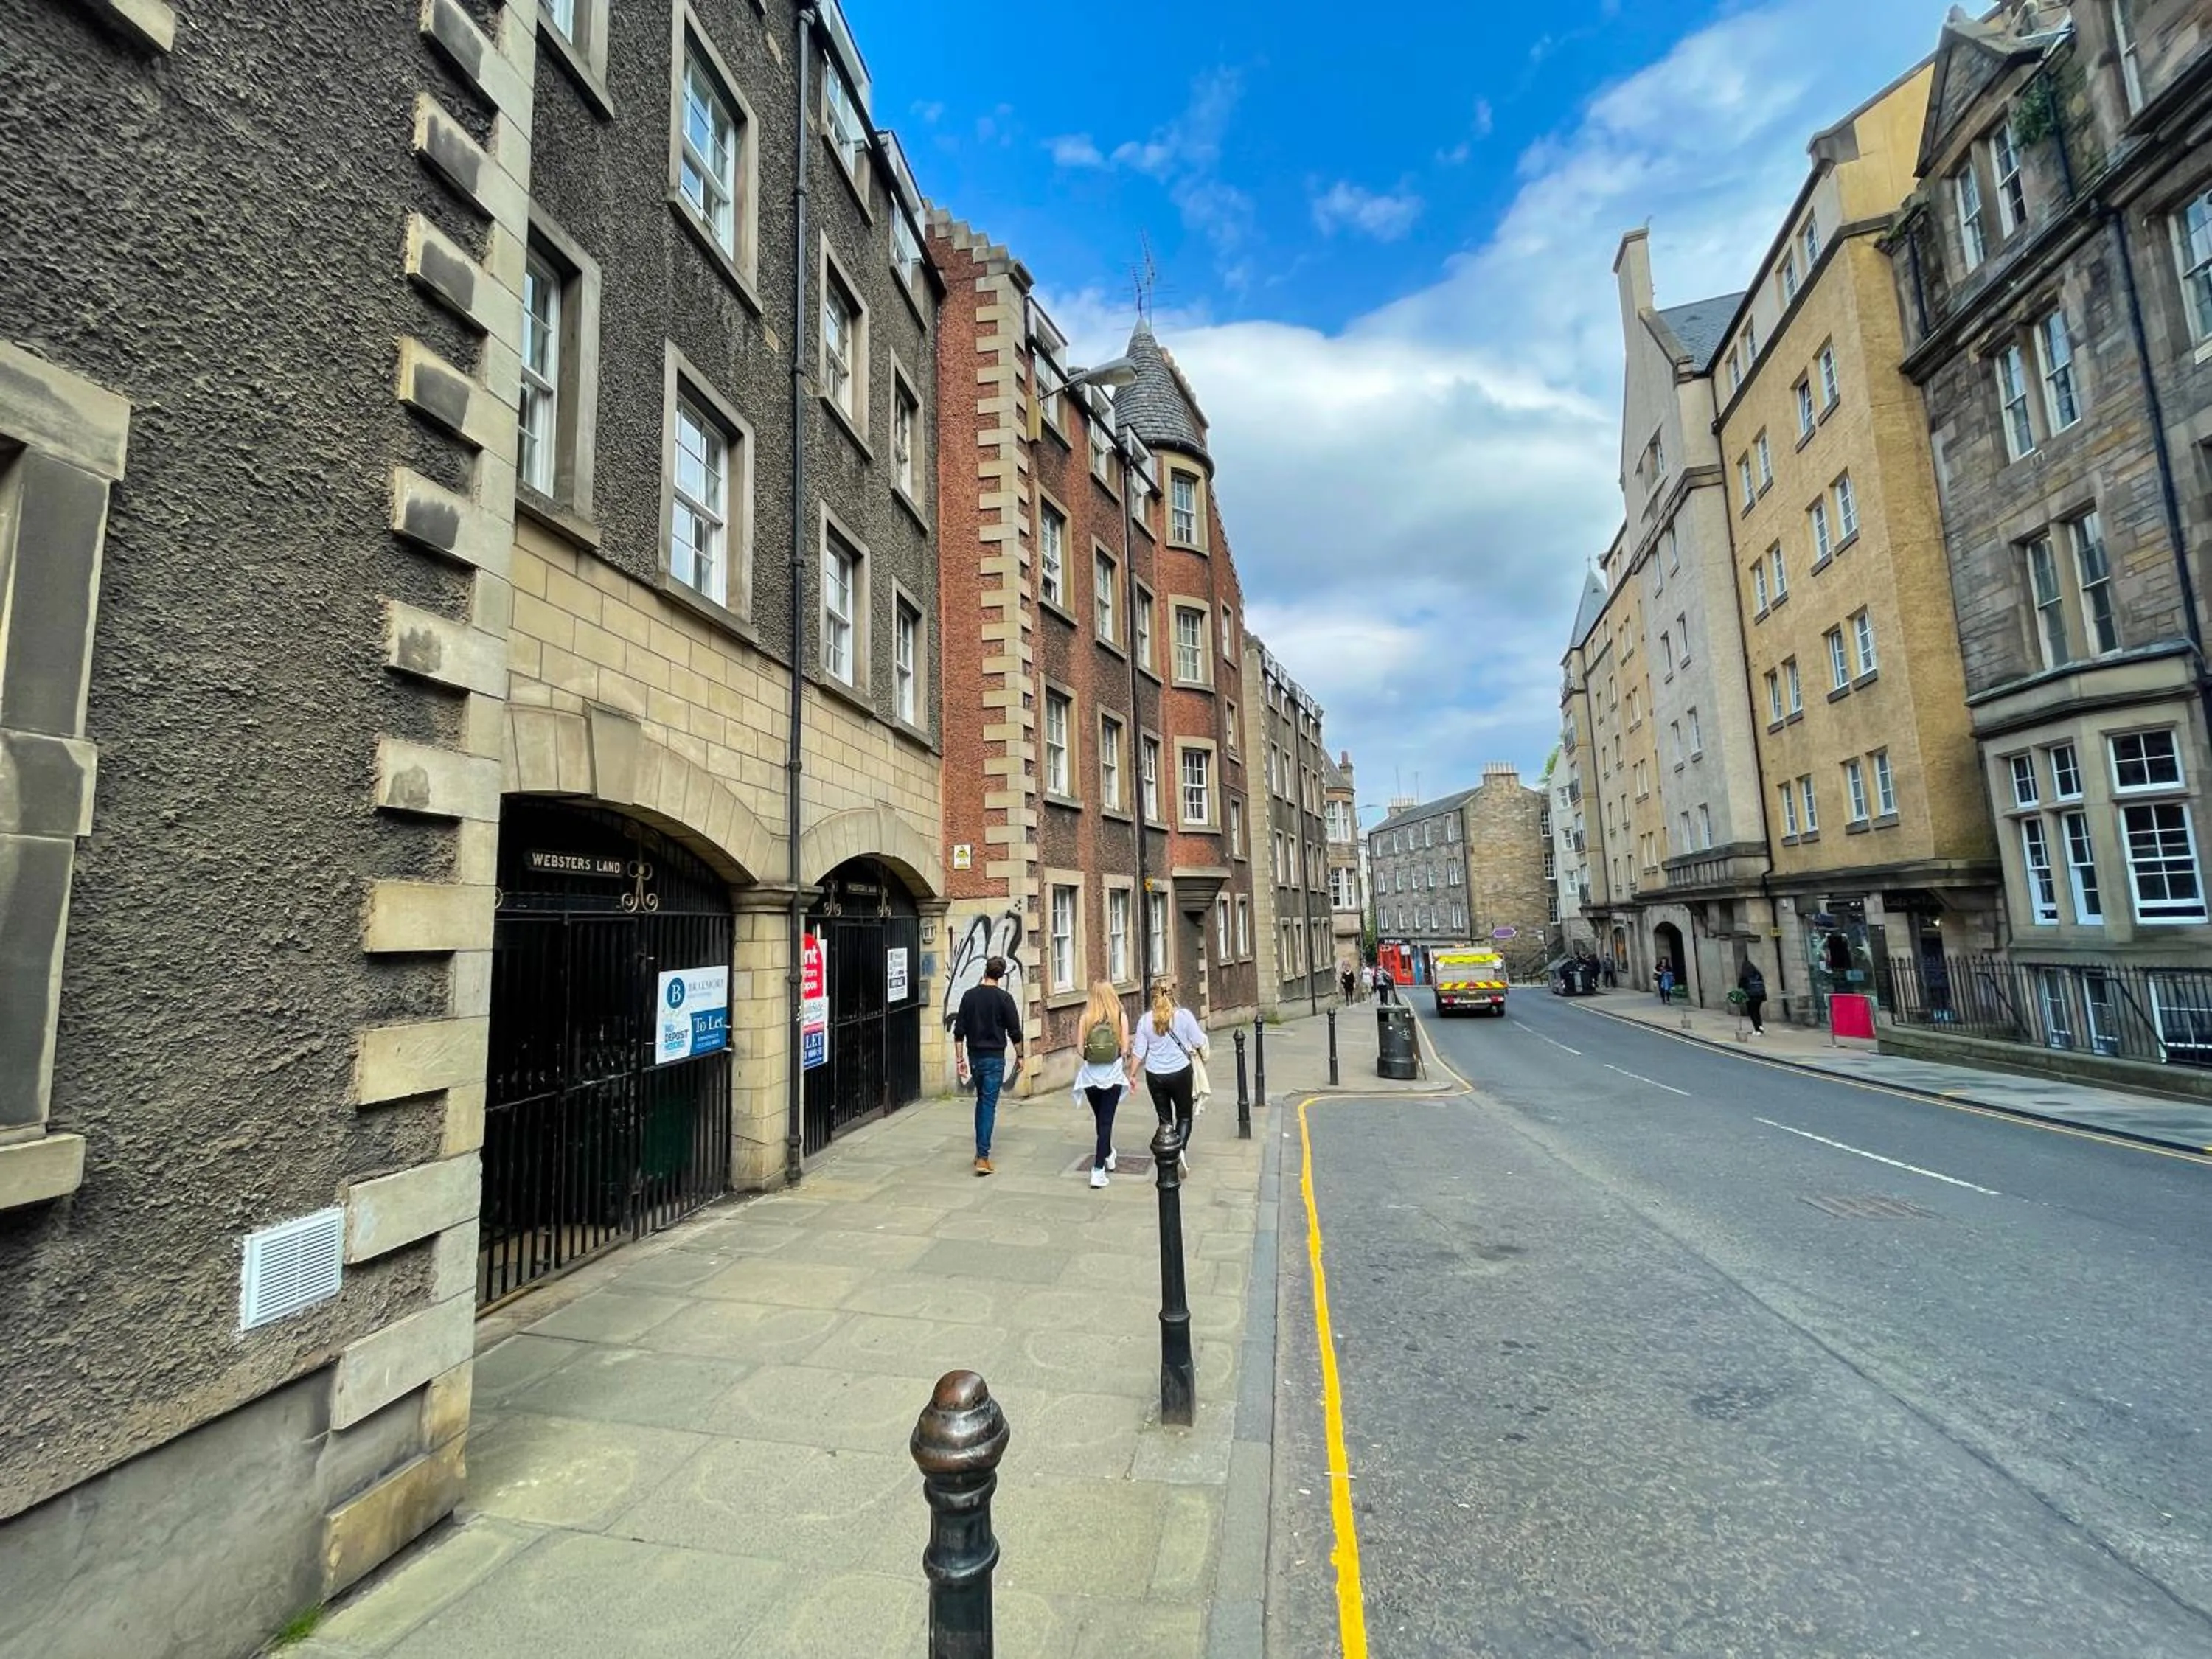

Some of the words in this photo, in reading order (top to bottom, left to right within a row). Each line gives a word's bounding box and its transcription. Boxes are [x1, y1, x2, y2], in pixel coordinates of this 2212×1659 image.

[532, 852, 591, 870] WEBSTERS
[596, 860, 620, 874] LAND
[804, 945, 818, 964] nt
[672, 984, 681, 1004] B
[693, 1017, 707, 1033] To
[709, 1015, 724, 1030] Let
[805, 1032, 823, 1049] LET
